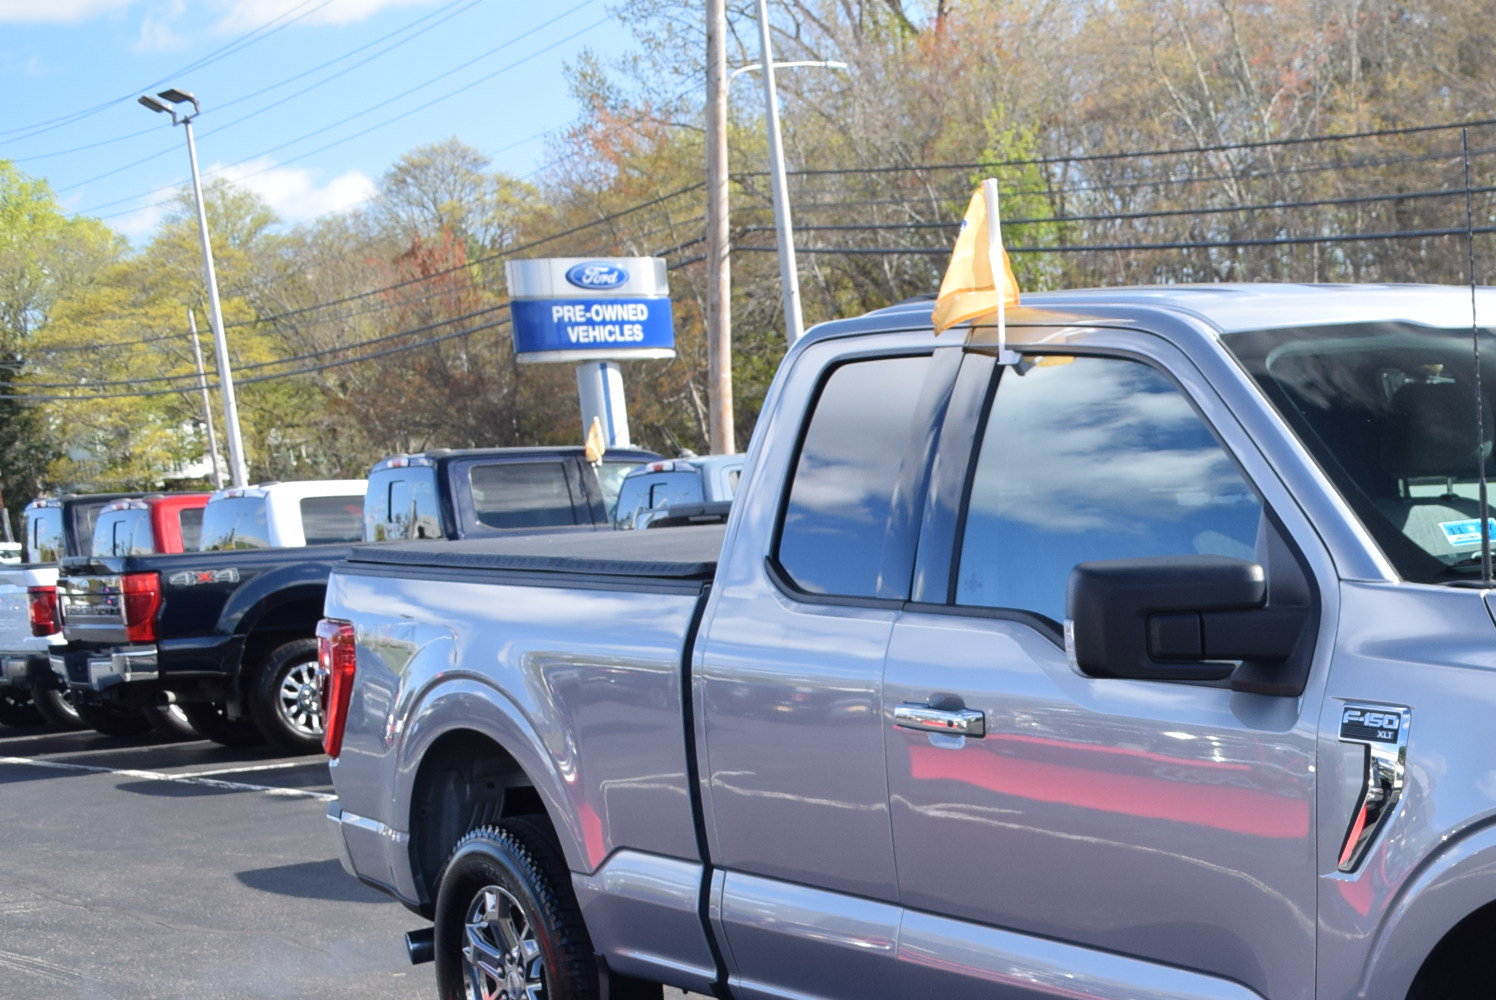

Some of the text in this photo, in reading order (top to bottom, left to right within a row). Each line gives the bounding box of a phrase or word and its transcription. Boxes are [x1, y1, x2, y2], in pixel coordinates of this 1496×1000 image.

[582, 267, 619, 285] Ford
[552, 304, 648, 323] PRE-OWNED
[567, 324, 644, 343] VEHICLES
[1343, 710, 1399, 729] F-150
[1377, 730, 1394, 739] XLT
